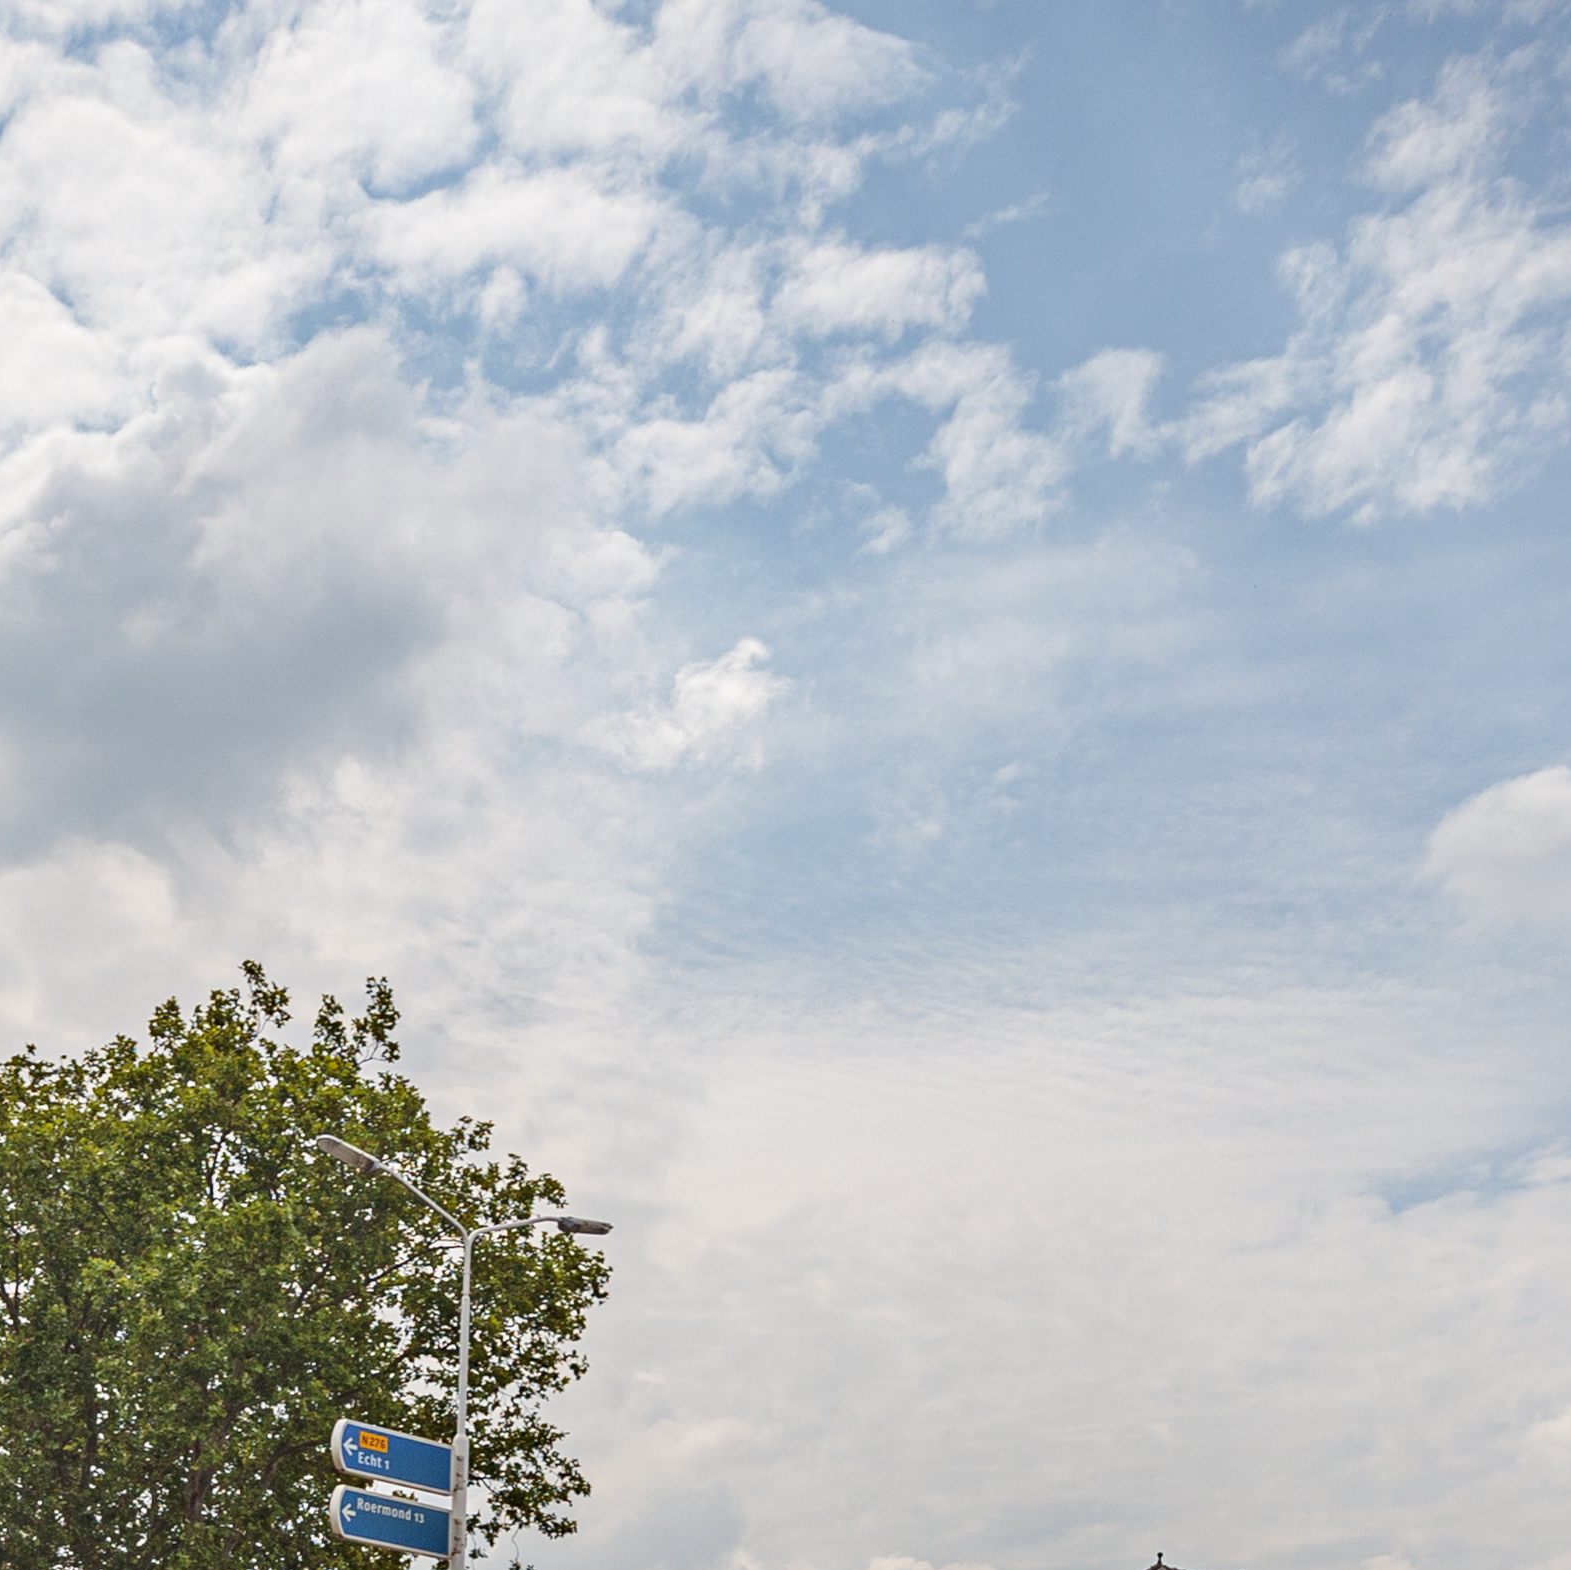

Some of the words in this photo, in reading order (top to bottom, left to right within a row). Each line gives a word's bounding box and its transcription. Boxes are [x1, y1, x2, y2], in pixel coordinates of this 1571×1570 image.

[357, 1451, 382, 1469] Echt
[384, 1460, 390, 1470] 1
[356, 1497, 412, 1521] Roermond
[414, 1512, 425, 1524] 13
